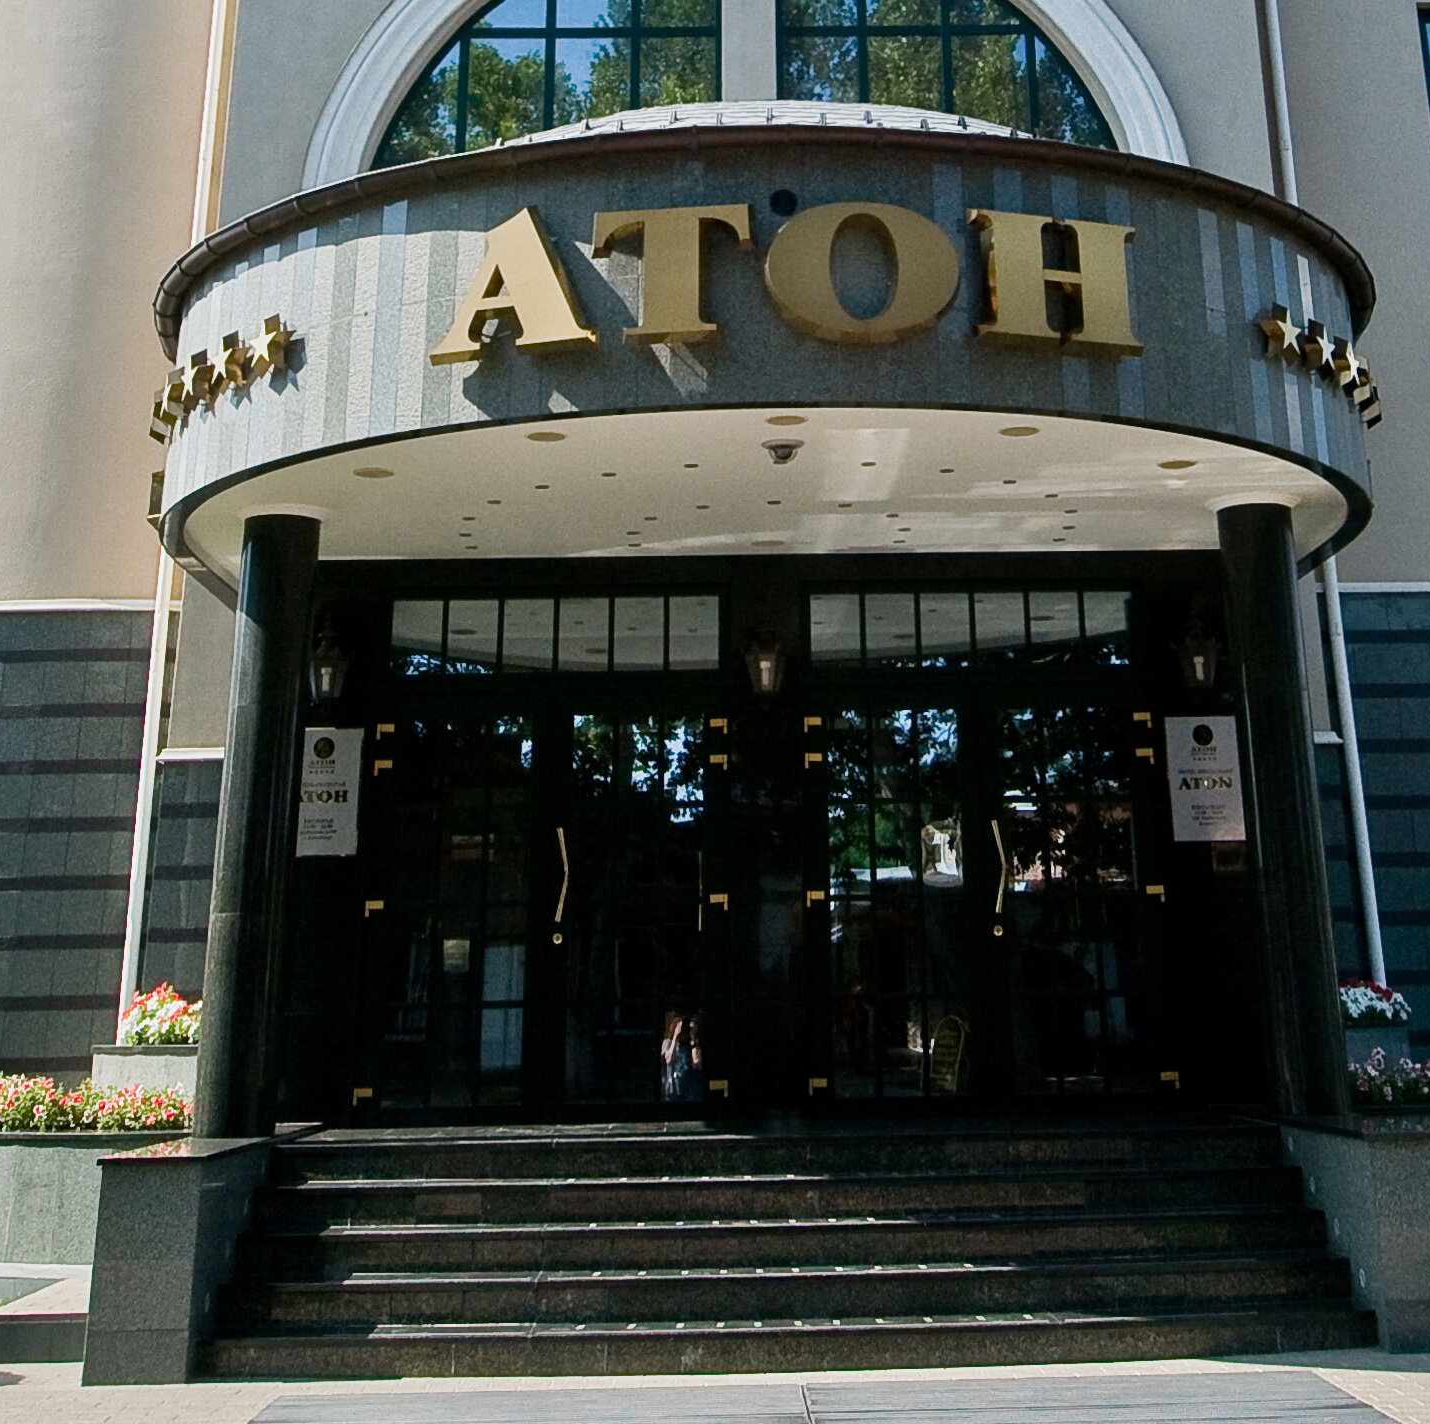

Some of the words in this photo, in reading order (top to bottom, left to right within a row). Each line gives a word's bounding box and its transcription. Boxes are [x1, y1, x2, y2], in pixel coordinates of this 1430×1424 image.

[430, 201, 1144, 366] АТОН
[1178, 776, 1233, 791] ATON
[299, 789, 348, 804] ТОН
